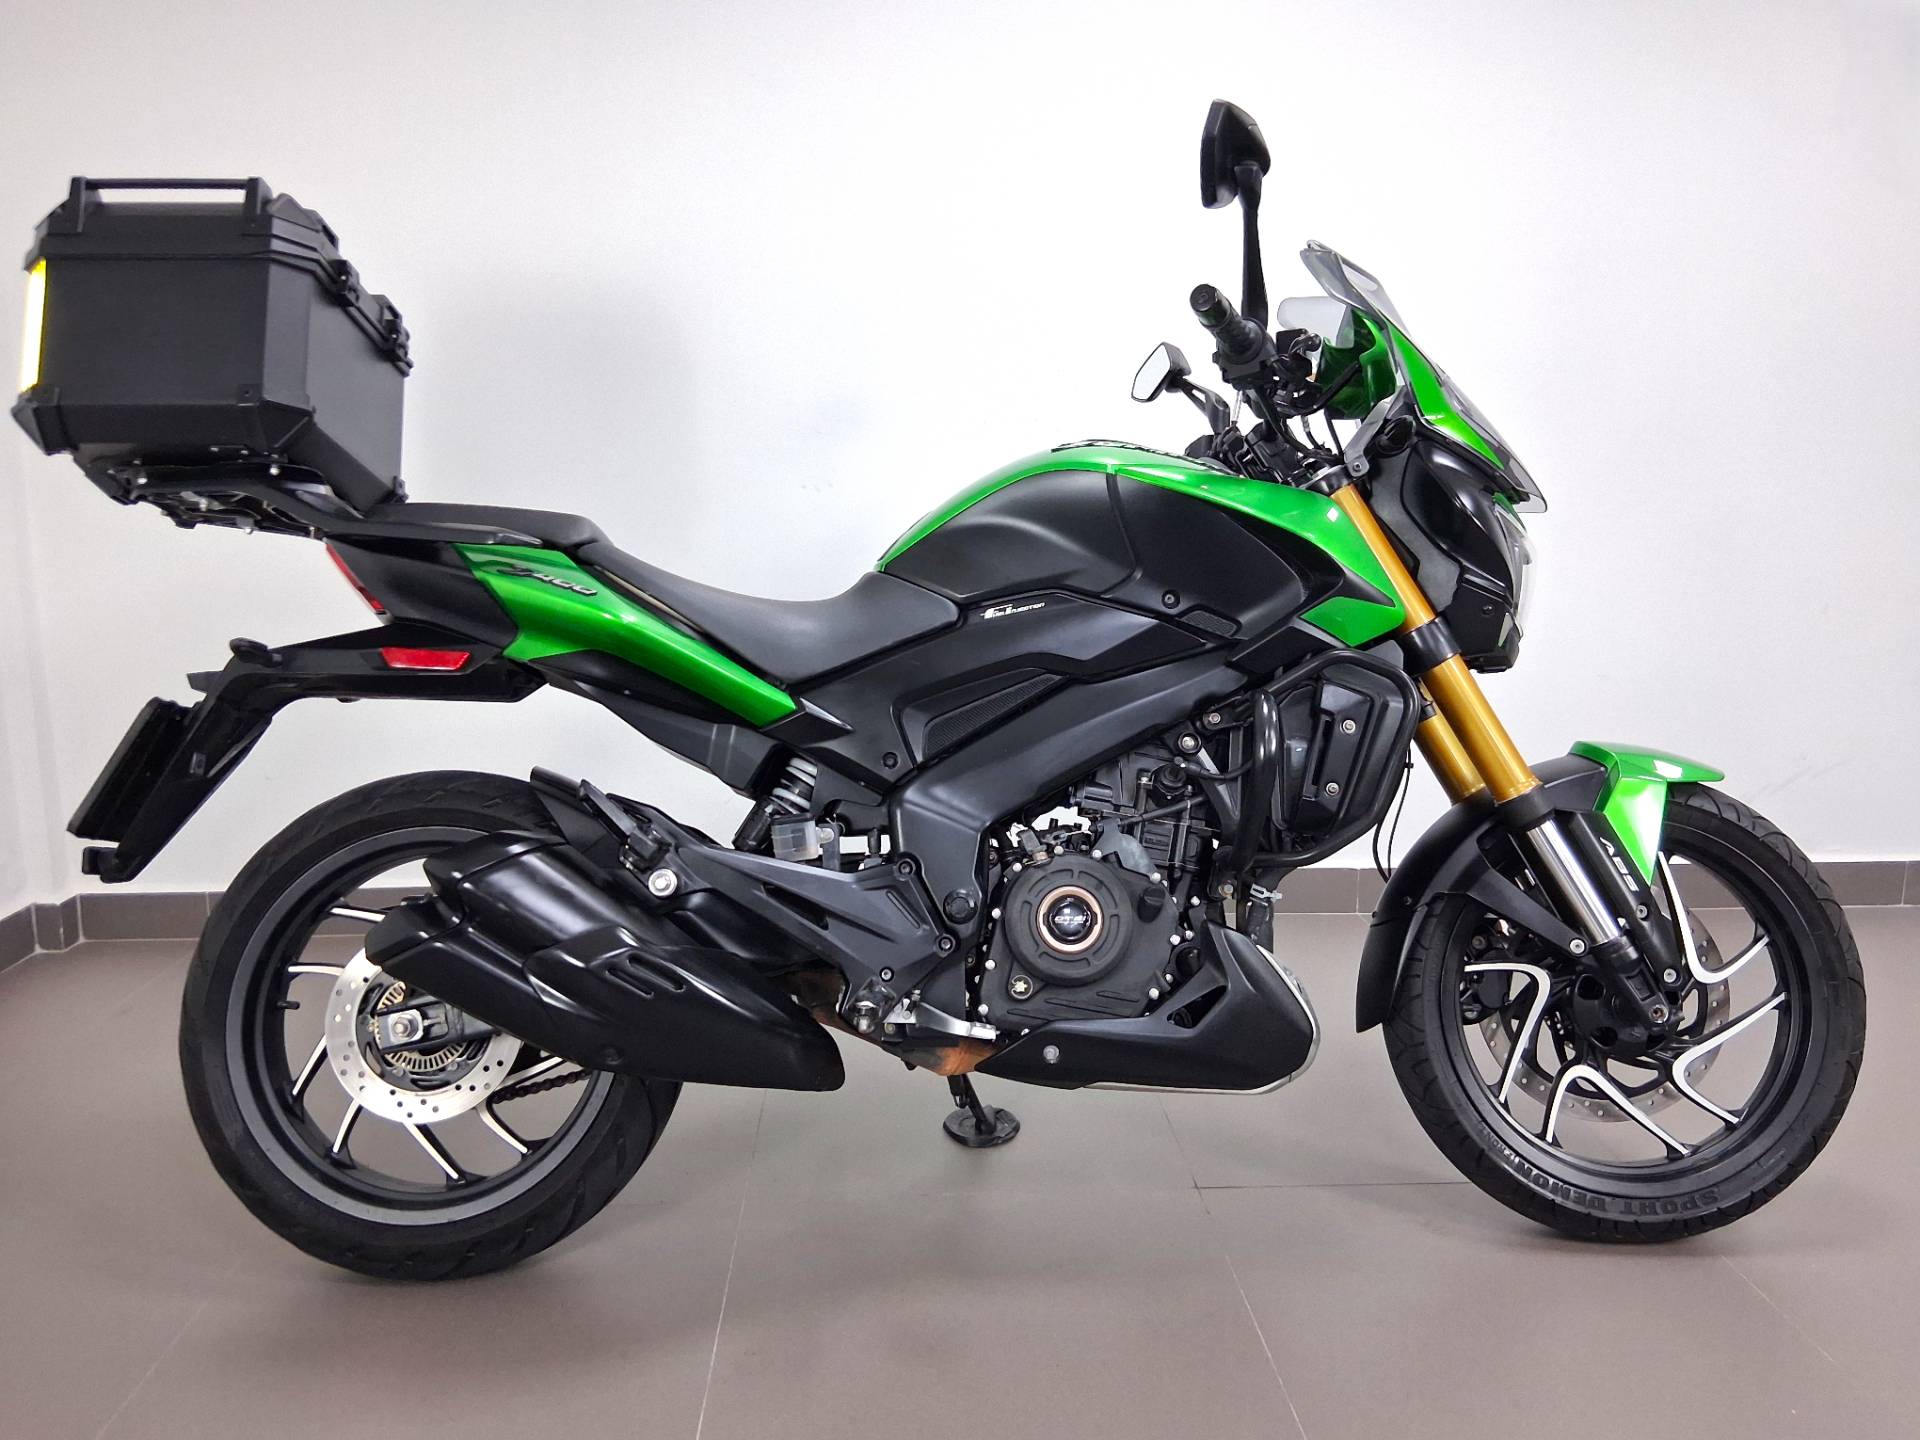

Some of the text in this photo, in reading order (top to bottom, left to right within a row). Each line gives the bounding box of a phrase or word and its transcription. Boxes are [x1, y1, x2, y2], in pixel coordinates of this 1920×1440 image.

[1599, 837, 1640, 892] ABS
[1512, 1158, 1608, 1214] DEMON
[1619, 1187, 1720, 1216] SPORT
